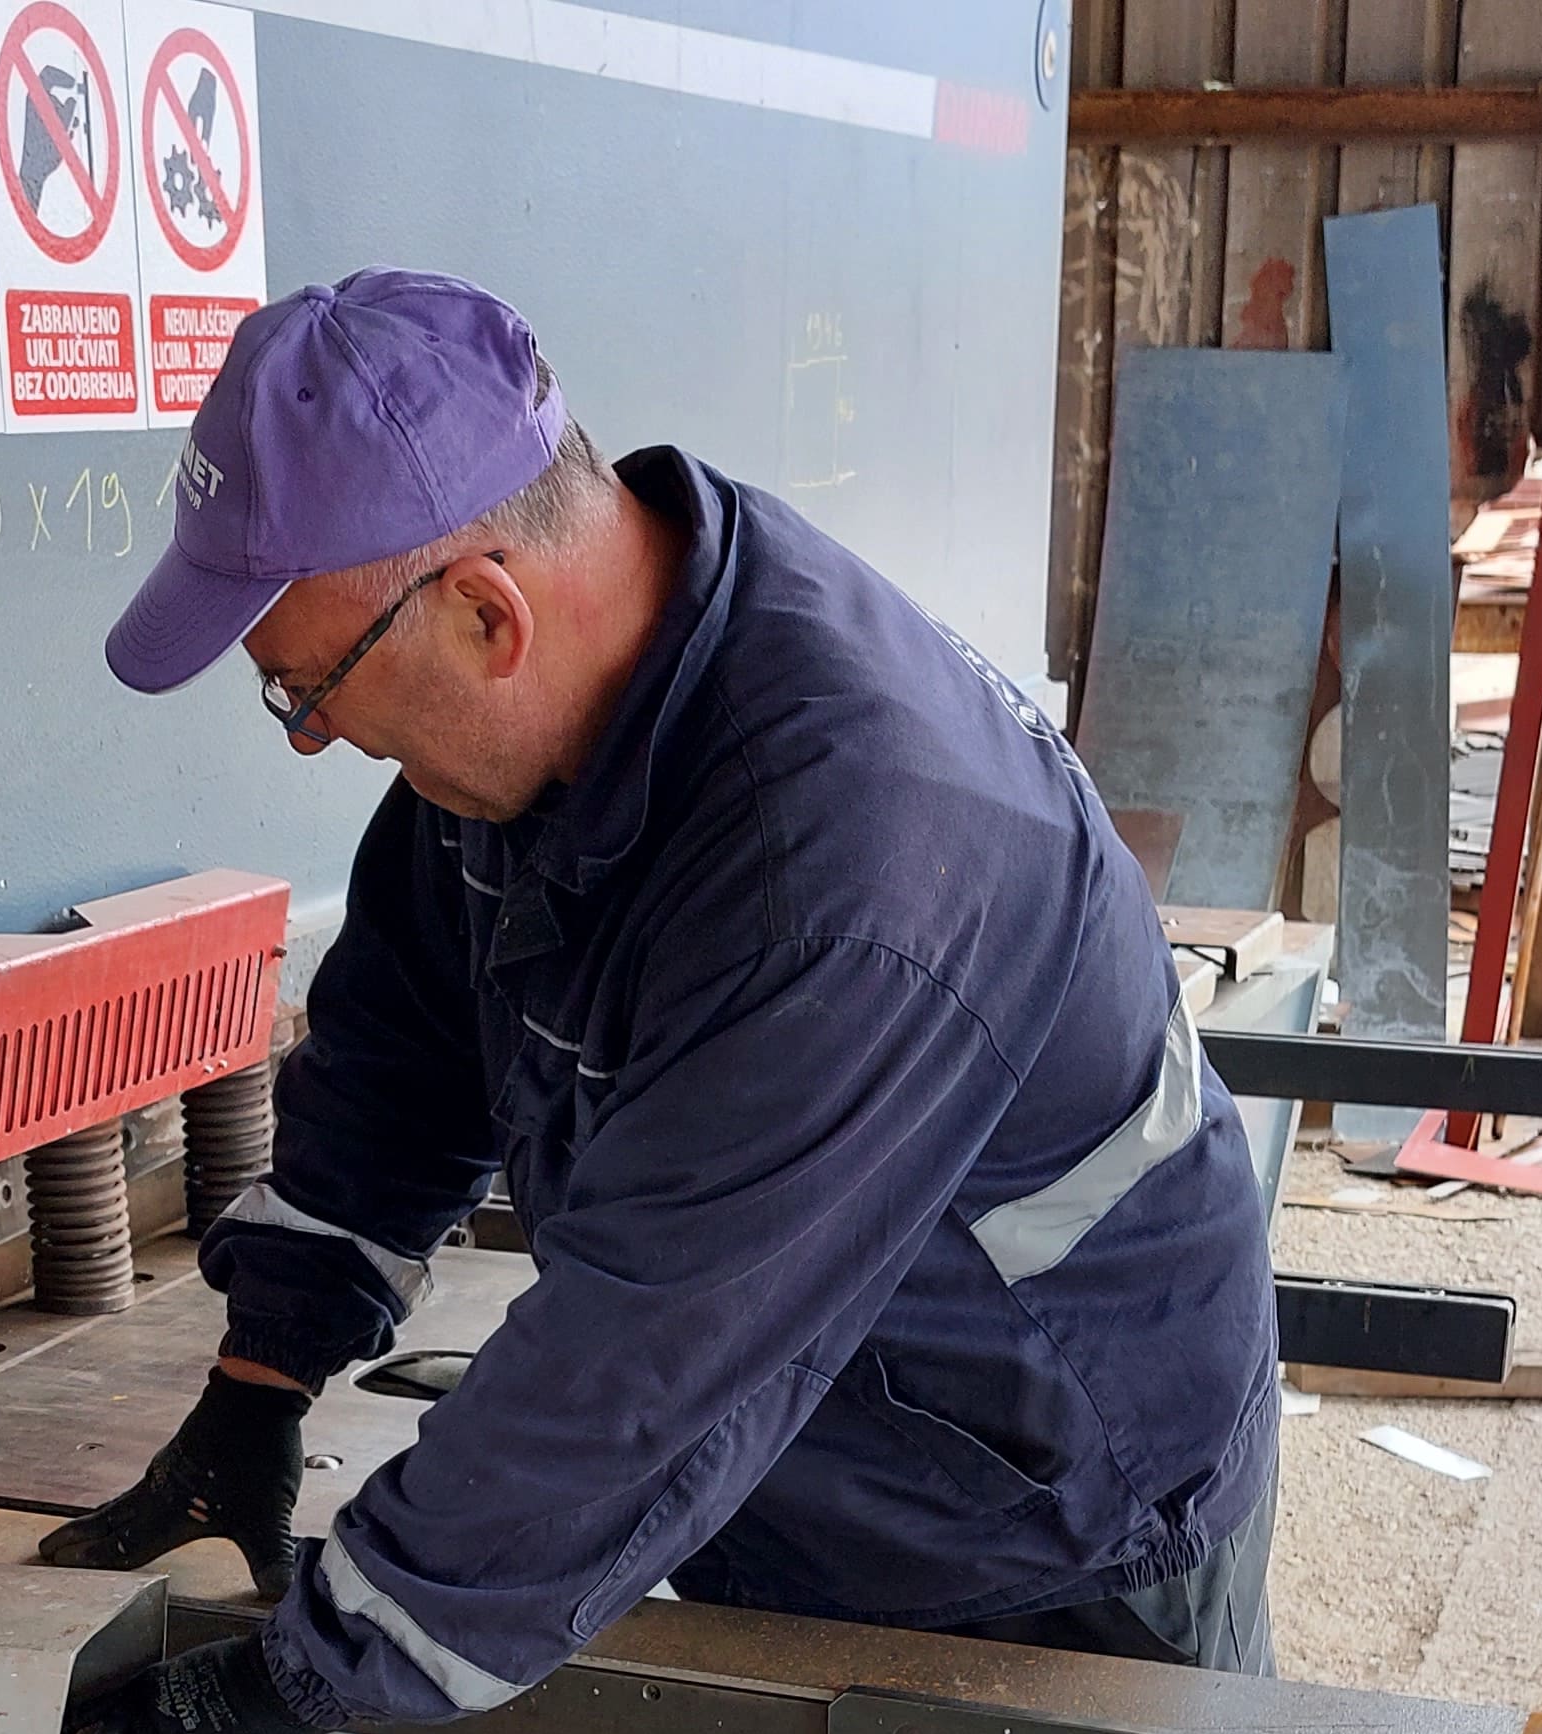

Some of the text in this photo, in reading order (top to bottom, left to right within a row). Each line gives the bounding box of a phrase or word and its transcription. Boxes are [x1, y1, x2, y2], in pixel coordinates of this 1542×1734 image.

[19, 303, 120, 335] ZABRANJENO
[25, 334, 120, 368] UKLJUČIVATI
[153, 341, 192, 369] LICIMA
[14, 371, 136, 401] BEZ ODOBRENJA
[66, 467, 133, 557] 19
